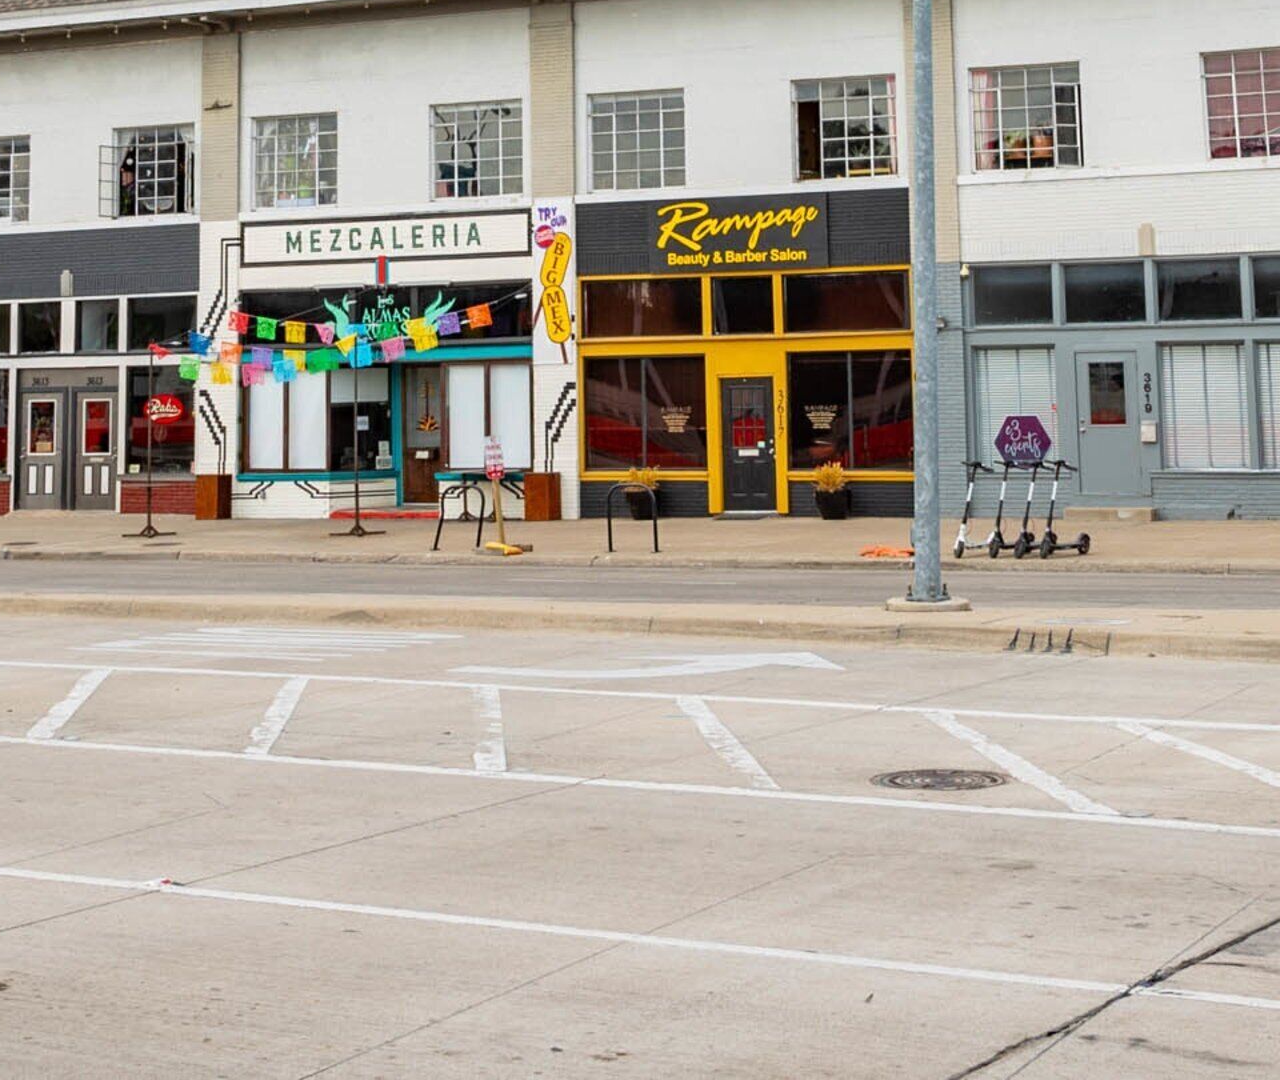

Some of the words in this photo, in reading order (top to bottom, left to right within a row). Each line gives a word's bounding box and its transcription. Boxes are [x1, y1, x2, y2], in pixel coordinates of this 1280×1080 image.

[537, 206, 557, 221] TRY
[657, 201, 818, 251] Rampage
[286, 222, 481, 254] MEZCALERIA
[546, 241, 565, 285] BIG
[668, 252, 710, 267] Beauty
[713, 252, 723, 264] &
[725, 250, 767, 264] Barber
[771, 248, 807, 262] Salon
[363, 306, 411, 323] ALMAS
[546, 291, 565, 335] MEX
[1143, 372, 1153, 414] 3619
